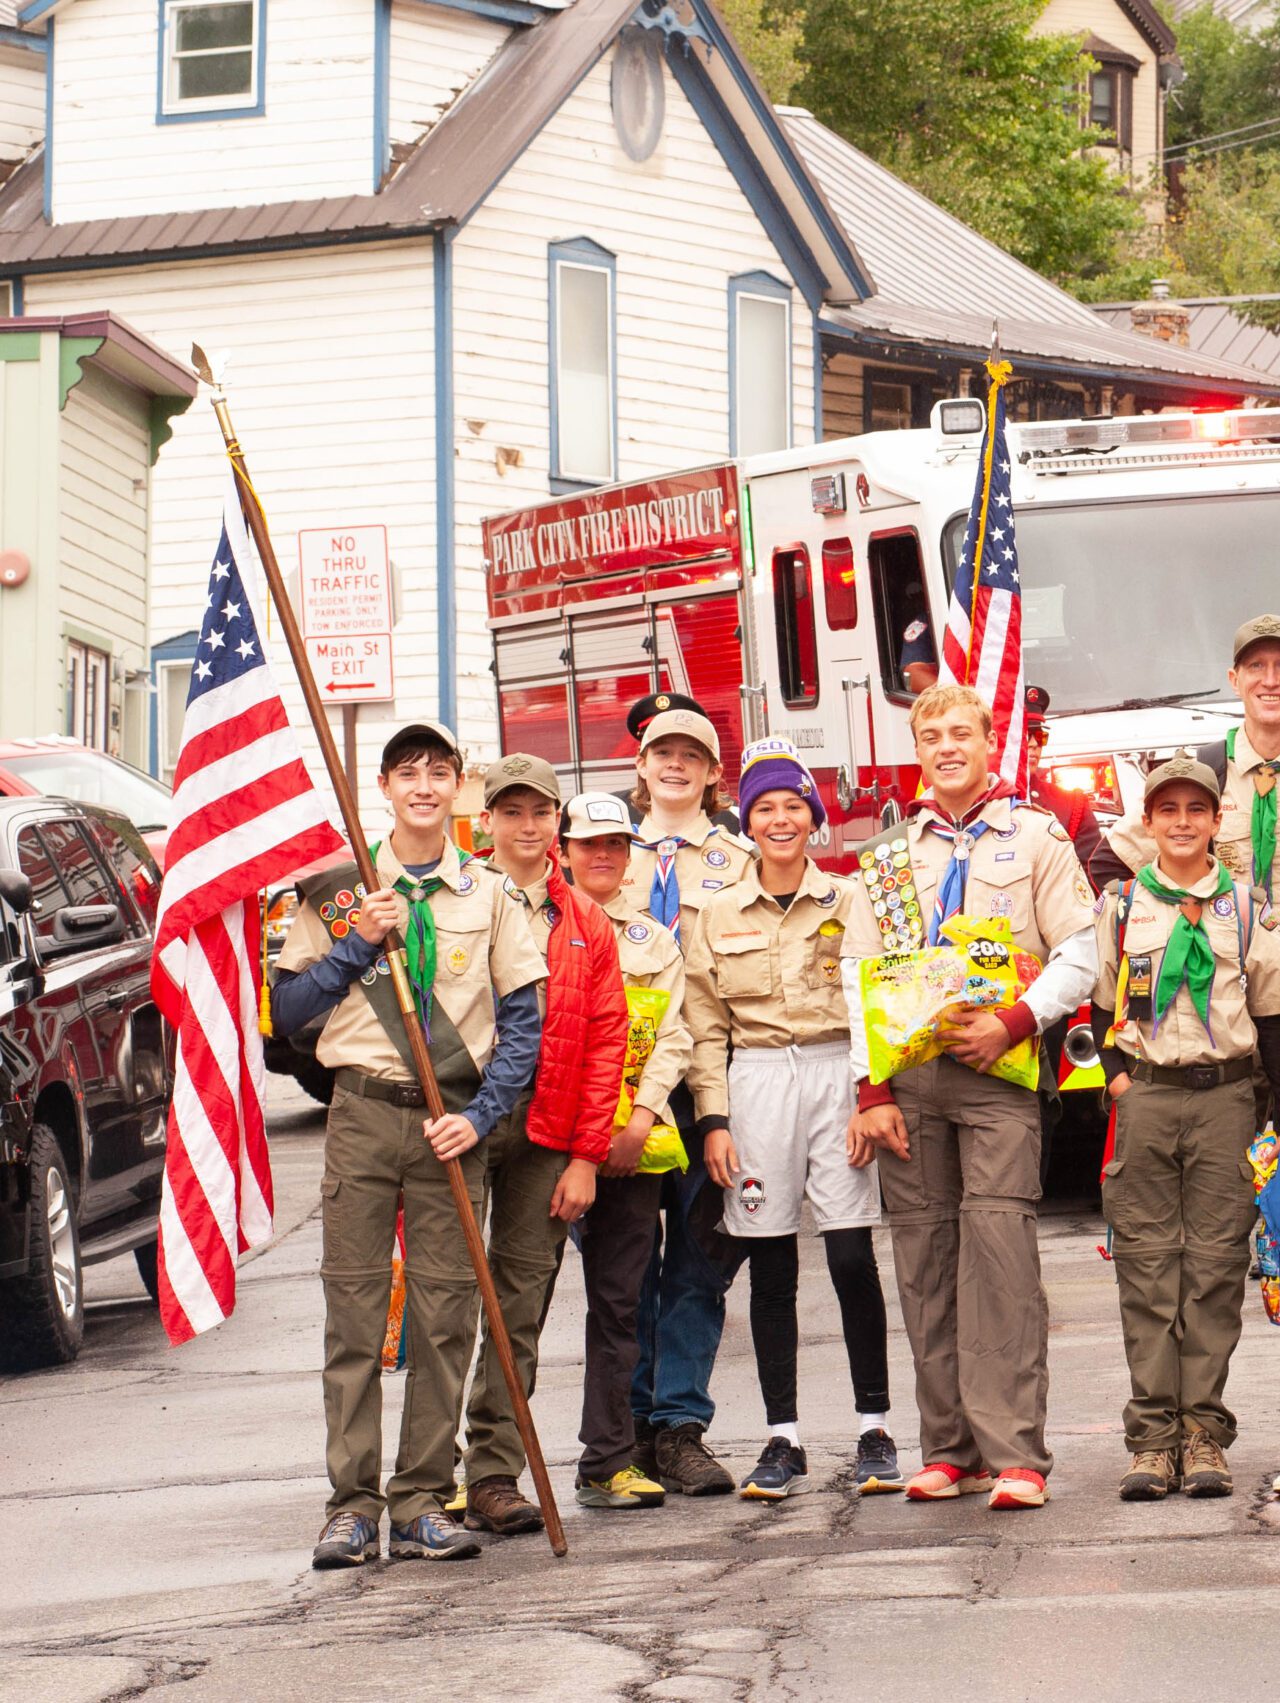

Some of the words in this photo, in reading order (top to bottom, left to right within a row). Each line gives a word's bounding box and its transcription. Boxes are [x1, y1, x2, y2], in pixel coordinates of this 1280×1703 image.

[492, 527, 536, 576] PARK
[537, 521, 578, 567] CITY
[579, 509, 625, 558] FIRE
[625, 487, 724, 550] DISTRICT
[331, 536, 356, 552] NO
[322, 556, 366, 572] THRU
[311, 574, 380, 592] TRAFFIC
[309, 596, 348, 606] RESIDENT
[353, 594, 383, 604] PERMIT
[315, 608, 350, 617] PARKING
[355, 607, 378, 615] ONLY
[311, 622, 330, 631] TOW
[335, 619, 384, 629] ENFORCED
[317, 644, 354, 658] Main
[364, 641, 379, 655] St
[331, 661, 365, 675] EXIT
[966, 941, 1008, 957] 200
